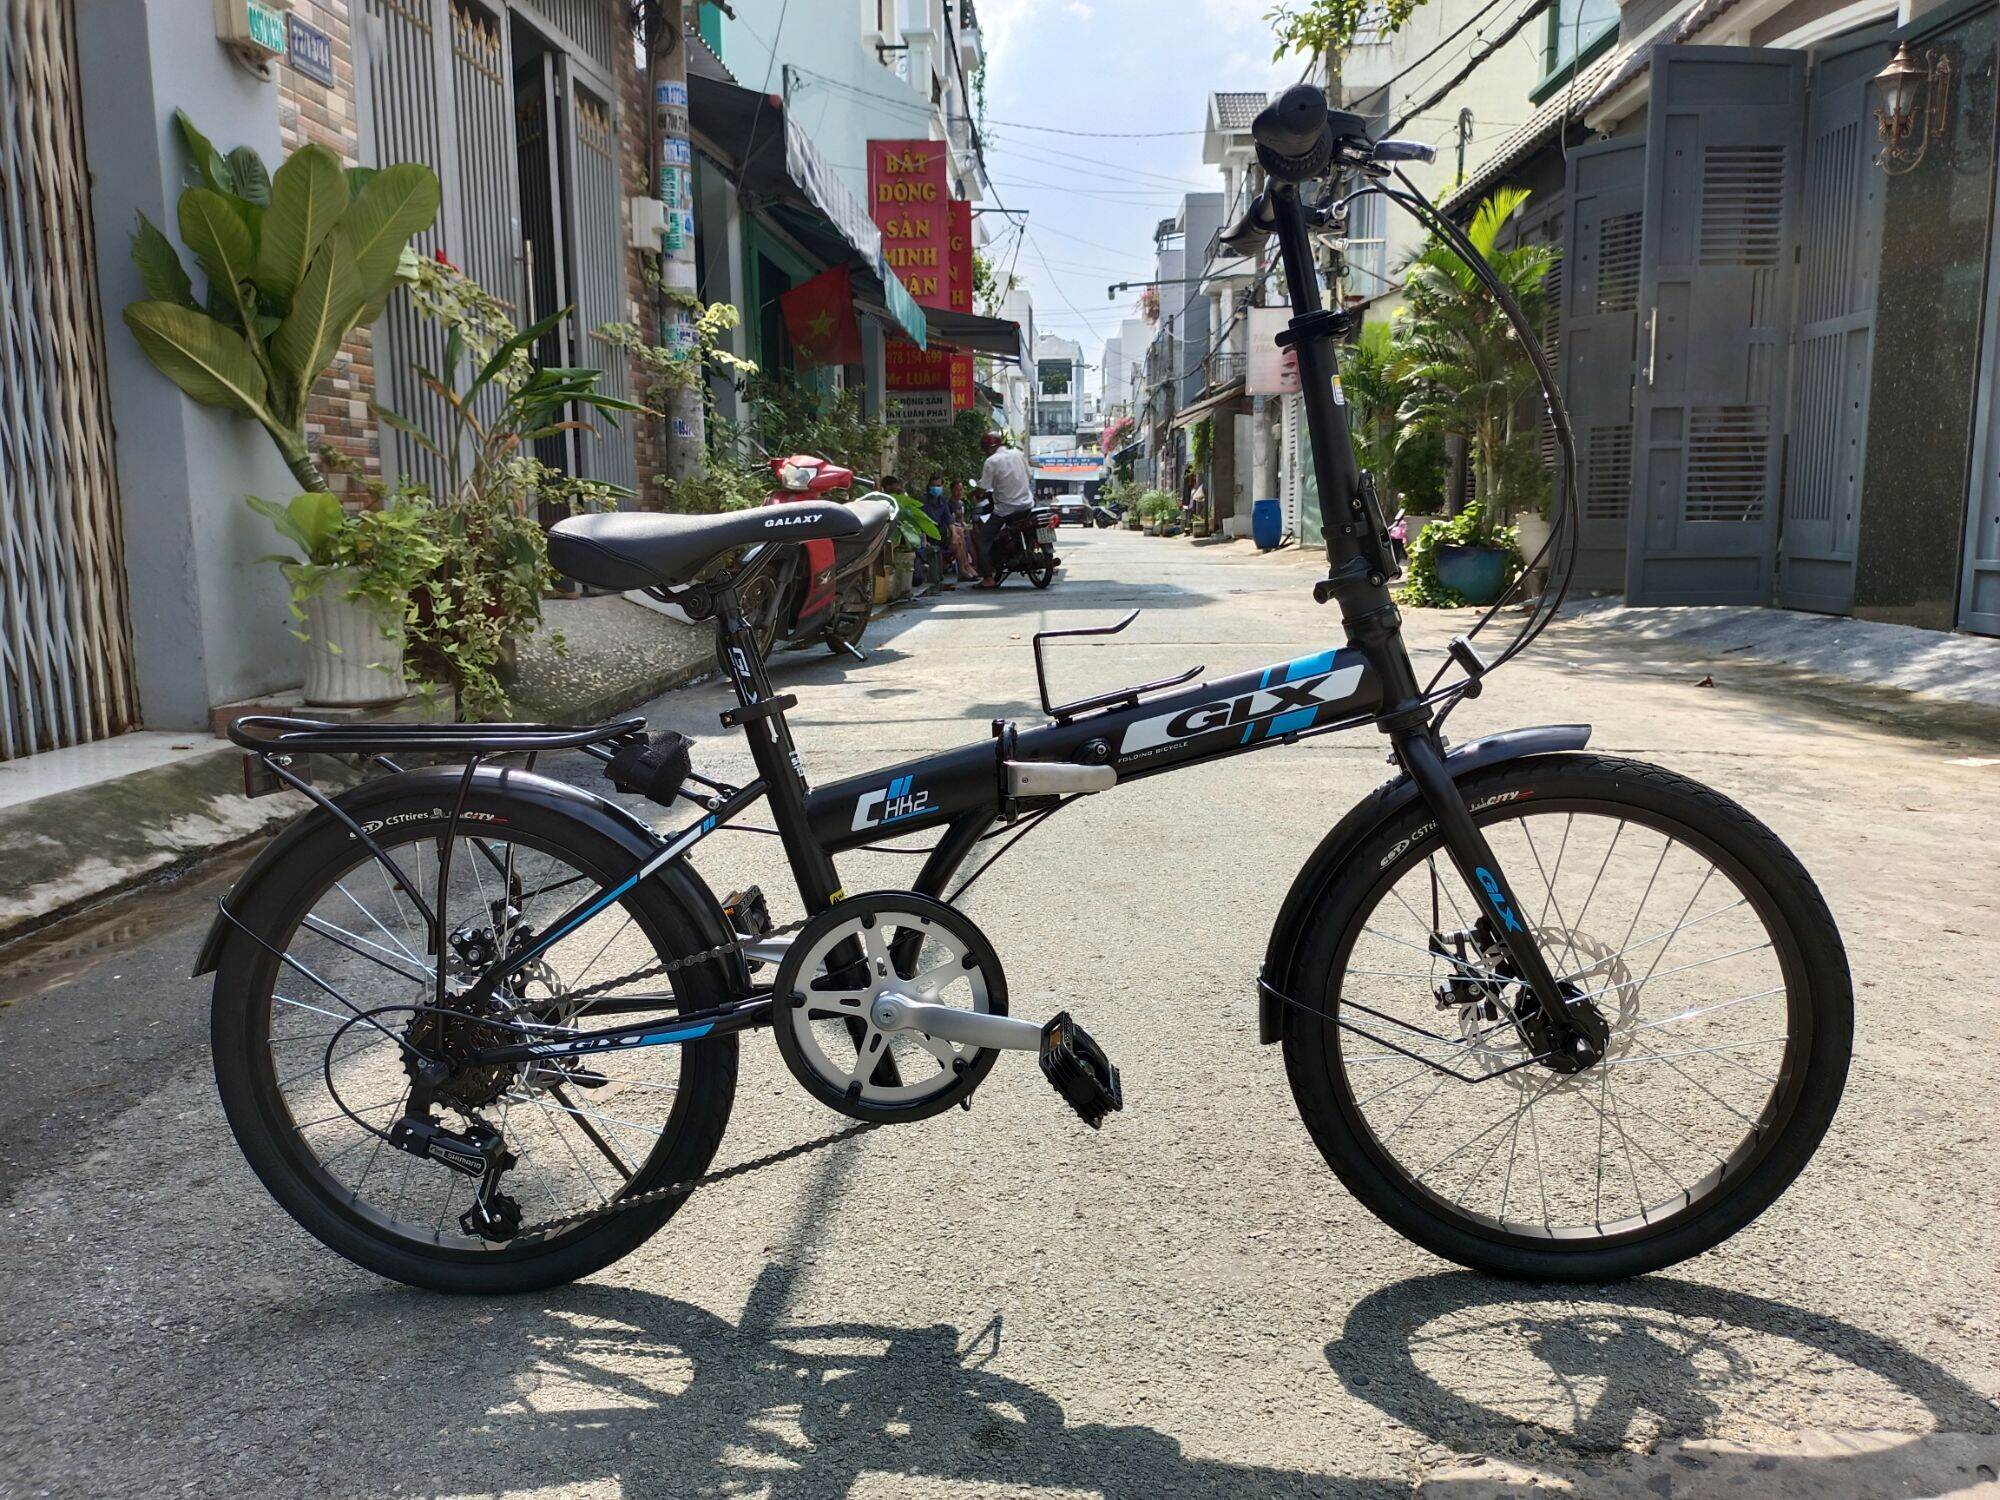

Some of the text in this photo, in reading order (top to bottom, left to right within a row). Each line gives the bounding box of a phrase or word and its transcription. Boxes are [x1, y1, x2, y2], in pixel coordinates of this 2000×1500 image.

[886, 211, 930, 238] SẢN
[764, 514, 823, 528] GALAXY
[1118, 741, 1189, 763] FOLDING BICYCLE
[385, 812, 429, 826] CSTtires
[1411, 819, 1438, 841] CSTti
[1474, 866, 1524, 934] GLX
[446, 1152, 482, 1169] SHIMANO
